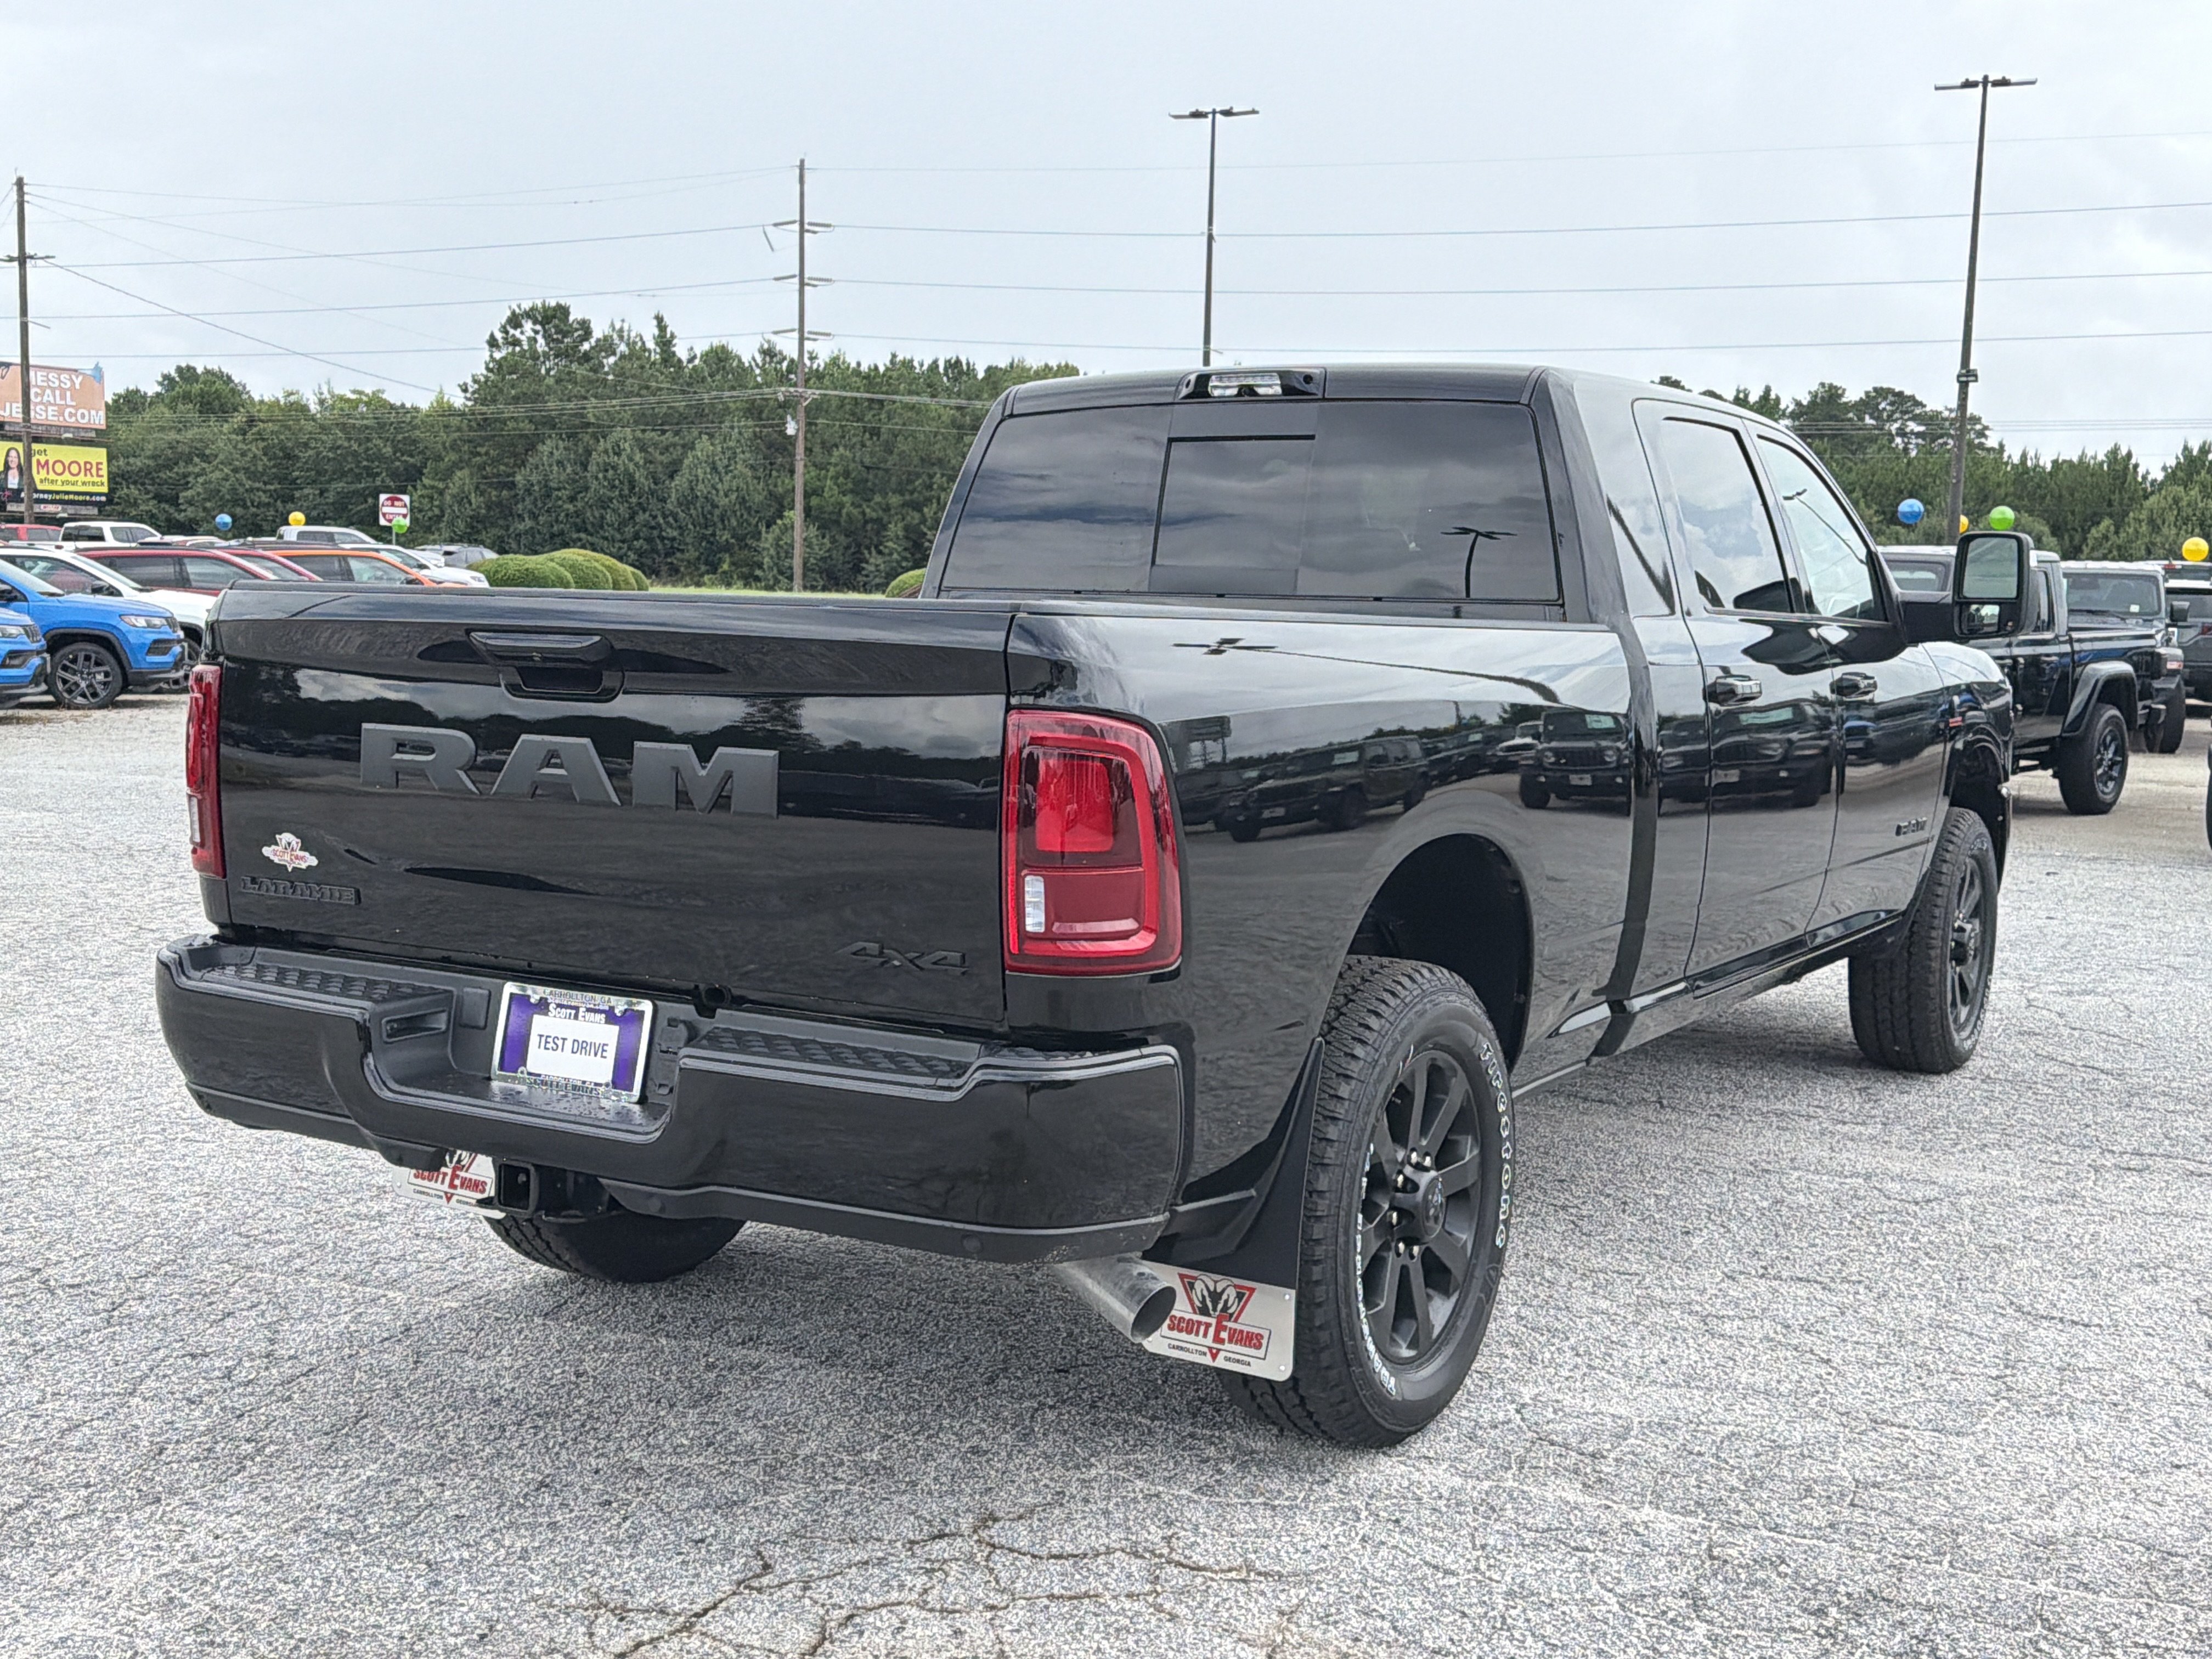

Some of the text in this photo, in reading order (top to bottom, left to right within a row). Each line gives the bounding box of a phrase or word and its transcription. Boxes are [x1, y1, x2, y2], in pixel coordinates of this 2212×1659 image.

[30, 387, 76, 405] CALL
[36, 458, 104, 478] MOORE
[39, 477, 59, 486] after
[20, 492, 106, 501] AorneyJulieMoore.com
[360, 722, 779, 819] RAM
[272, 848, 289, 859] SCOTT
[240, 876, 362, 905] LARAMIE
[600, 995, 612, 1005] GA
[548, 1003, 576, 1019] SCOTT
[578, 1007, 606, 1024] EVANS
[537, 1034, 609, 1059] TEST DRIVE
[448, 1164, 488, 1194] EVANS
[413, 1188, 443, 1200] CARROLLTON
[1167, 1313, 1264, 1351] SCOTT EVANS
[1167, 1343, 1251, 1368] CARROLLTON GEORGIA
